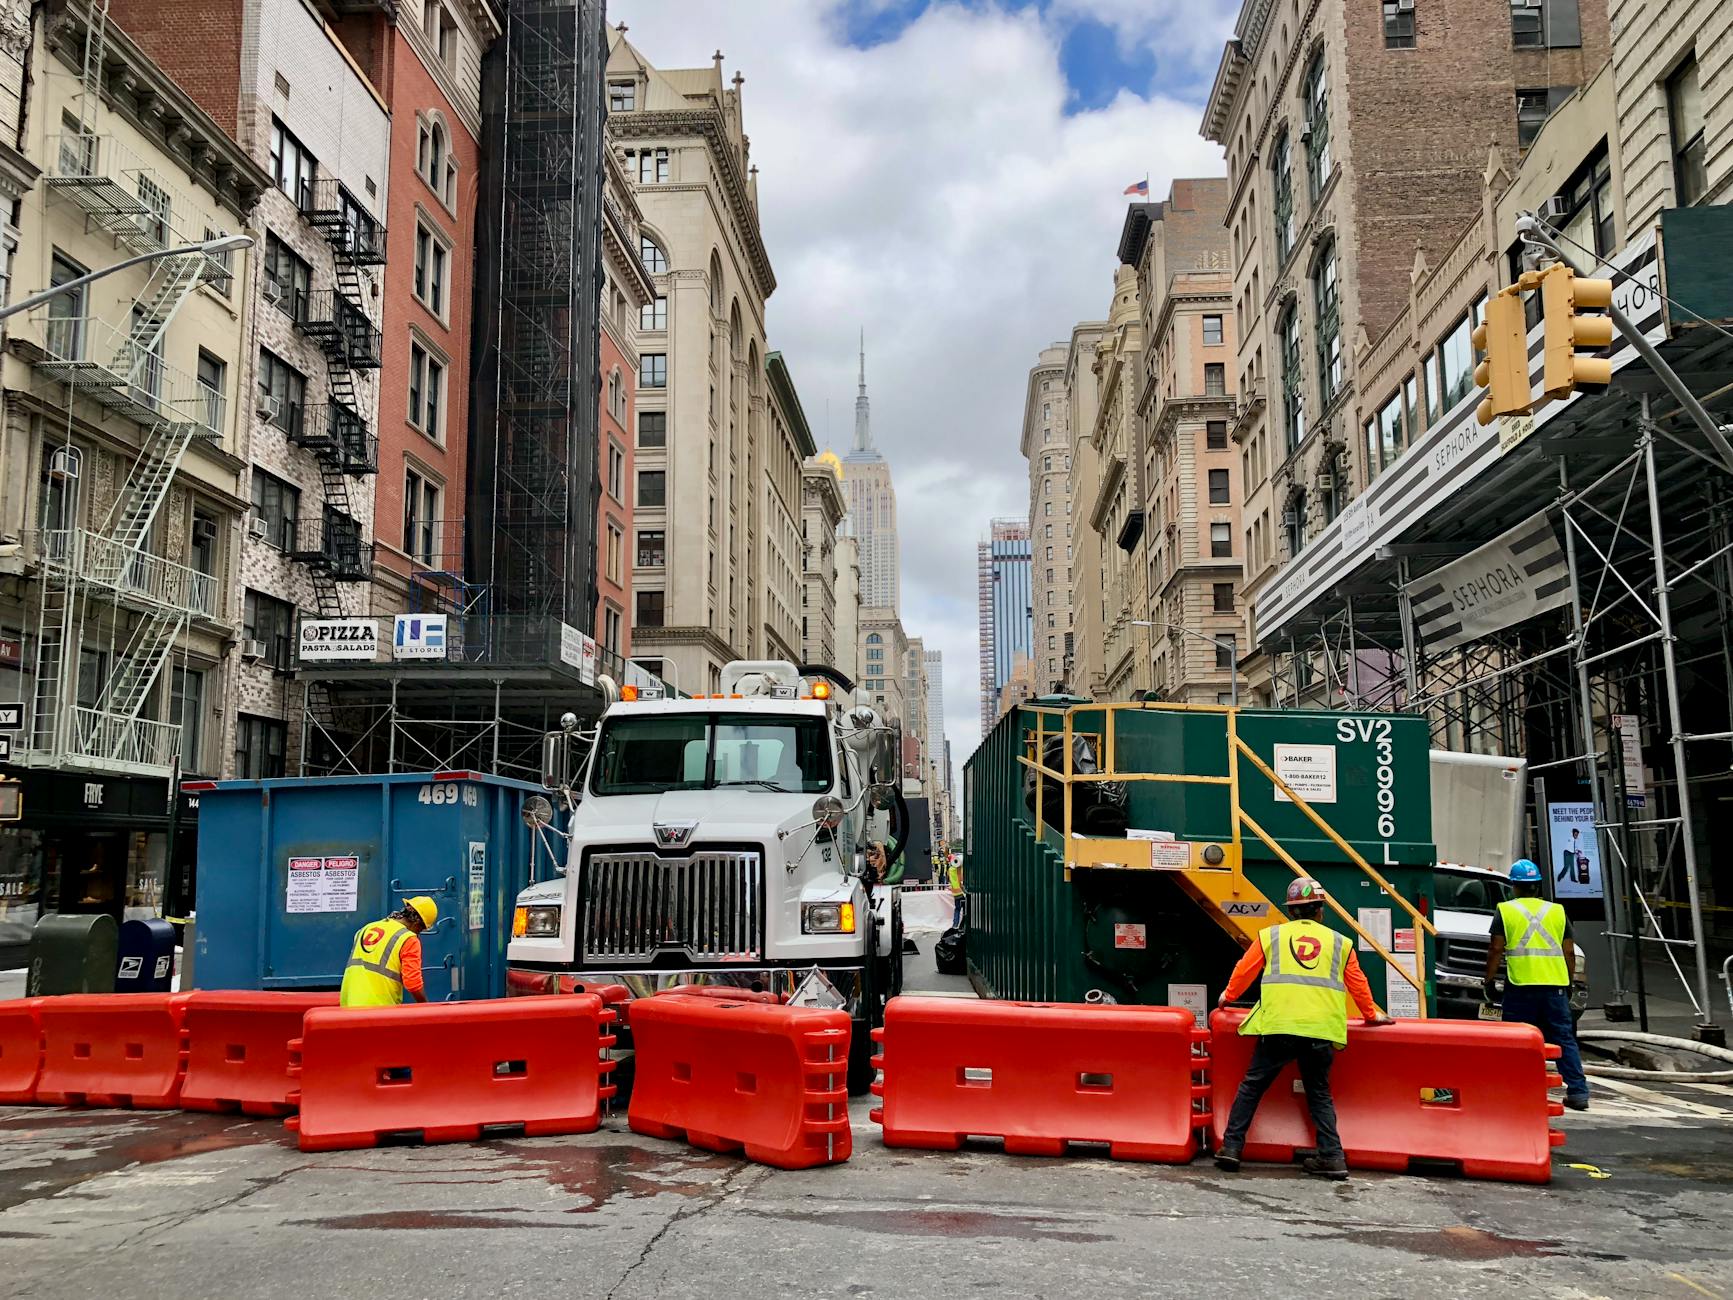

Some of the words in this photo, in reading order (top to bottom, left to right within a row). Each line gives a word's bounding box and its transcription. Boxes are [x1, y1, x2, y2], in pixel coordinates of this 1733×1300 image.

[1435, 422, 1479, 471] SEPHORA
[1453, 562, 1525, 611] SEPHORA
[317, 625, 375, 641] PIZZA
[301, 644, 331, 652] PASTA
[337, 643, 376, 652] SALADS
[1288, 755, 1313, 763] BAKER
[84, 783, 104, 805] FRYE
[418, 783, 459, 805] 469
[462, 785, 478, 807] 469
[1554, 815, 1574, 823] BEHIND
[1575, 815, 1589, 823] YOUR
[1579, 807, 1594, 816] PEOP
[821, 847, 832, 863] 132
[294, 860, 318, 868] DANGER
[328, 860, 354, 868] PELIGRO
[324, 870, 356, 878] ASBESTOS
[0, 881, 24, 896] SALE
